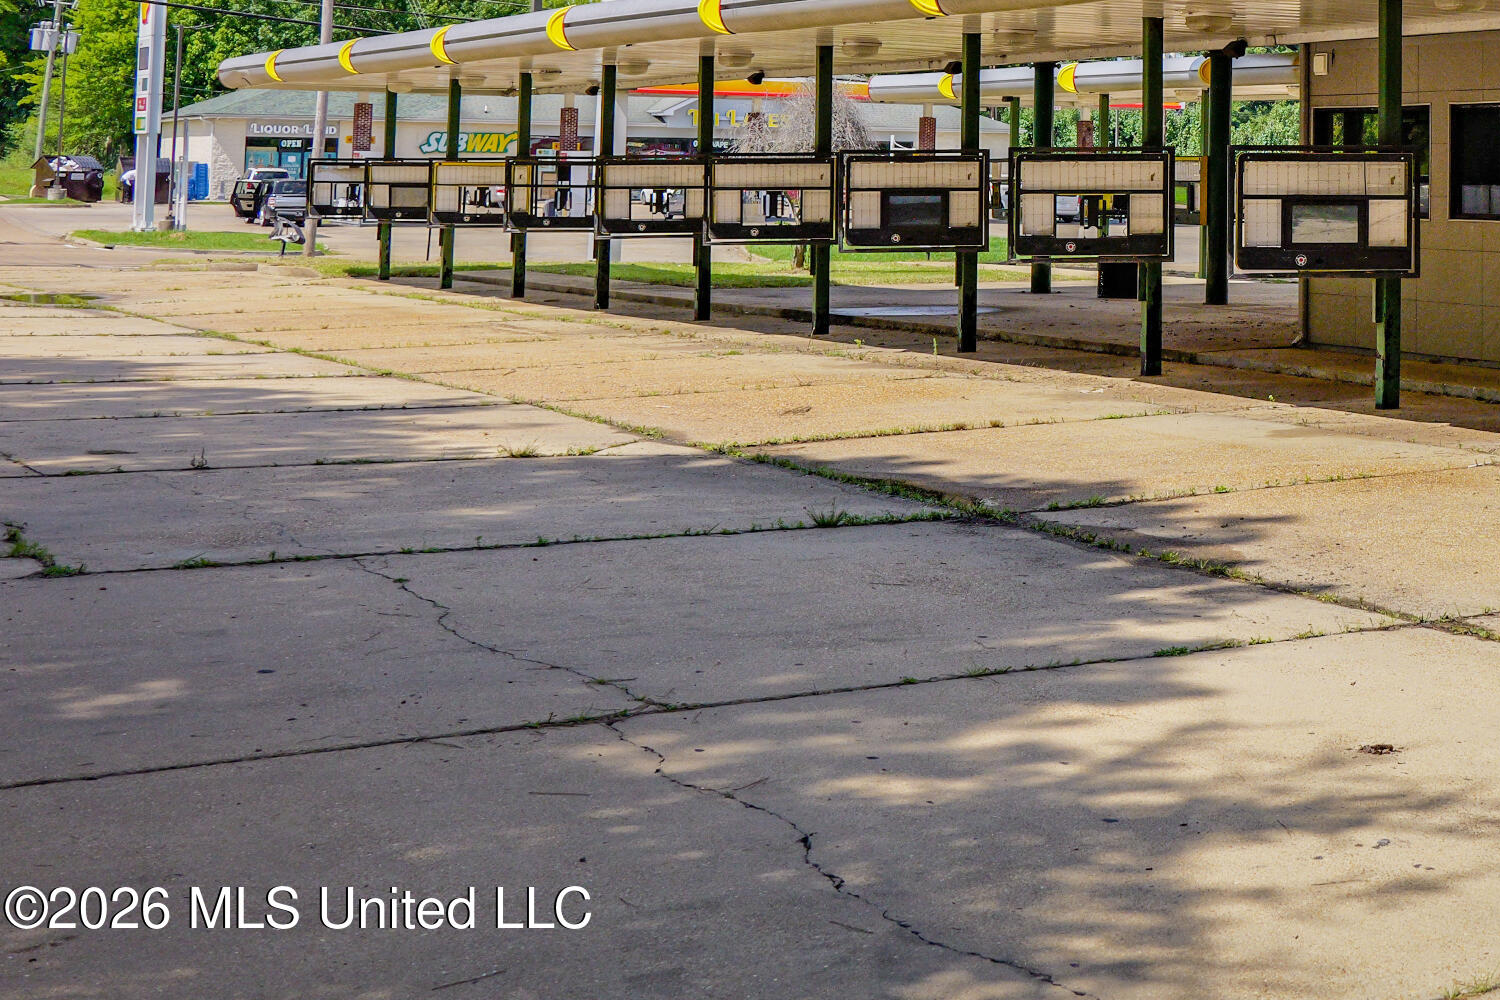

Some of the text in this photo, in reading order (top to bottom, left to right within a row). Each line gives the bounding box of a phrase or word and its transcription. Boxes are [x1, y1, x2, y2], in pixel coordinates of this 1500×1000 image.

[250, 122, 337, 136] LIQUOR LD
[280, 139, 303, 149] OPEN
